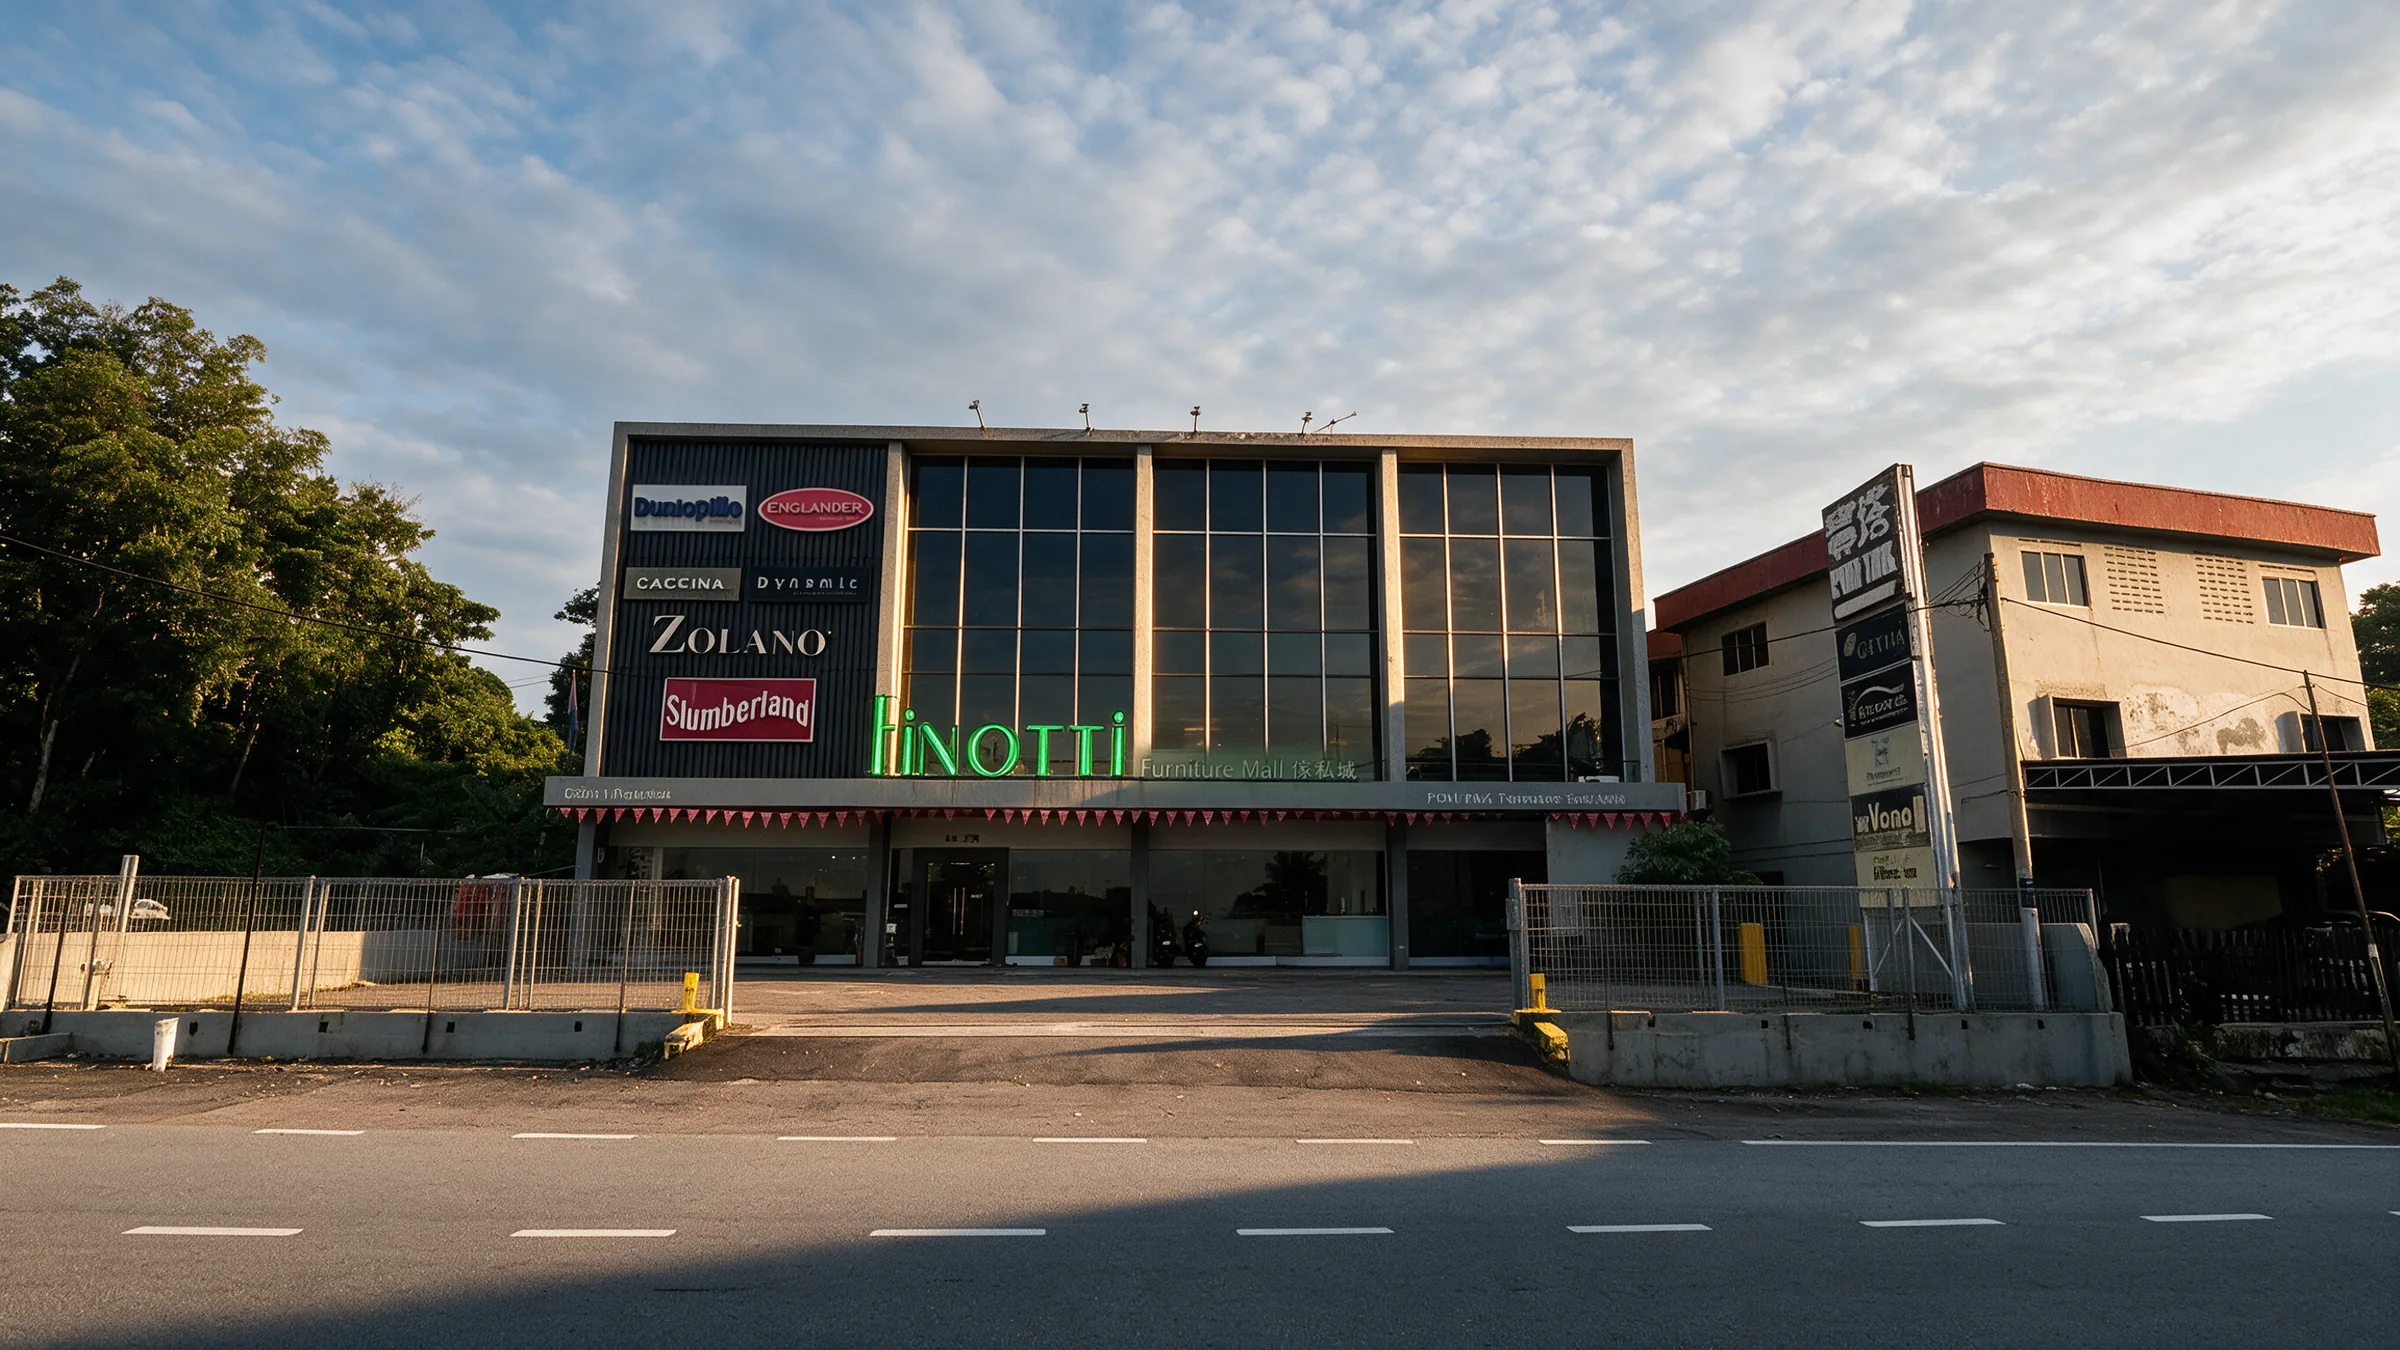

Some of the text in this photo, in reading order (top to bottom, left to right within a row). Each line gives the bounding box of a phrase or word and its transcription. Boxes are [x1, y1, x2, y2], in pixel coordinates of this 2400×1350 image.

[767, 502, 865, 515] ENGLANDER
[636, 577, 725, 590] CACCINA
[649, 615, 826, 656] ZOLANO
[666, 690, 809, 731] Slumberland
[1141, 758, 1358, 780] Furniture Mall 傢私城
[1868, 801, 1912, 832] Vono
